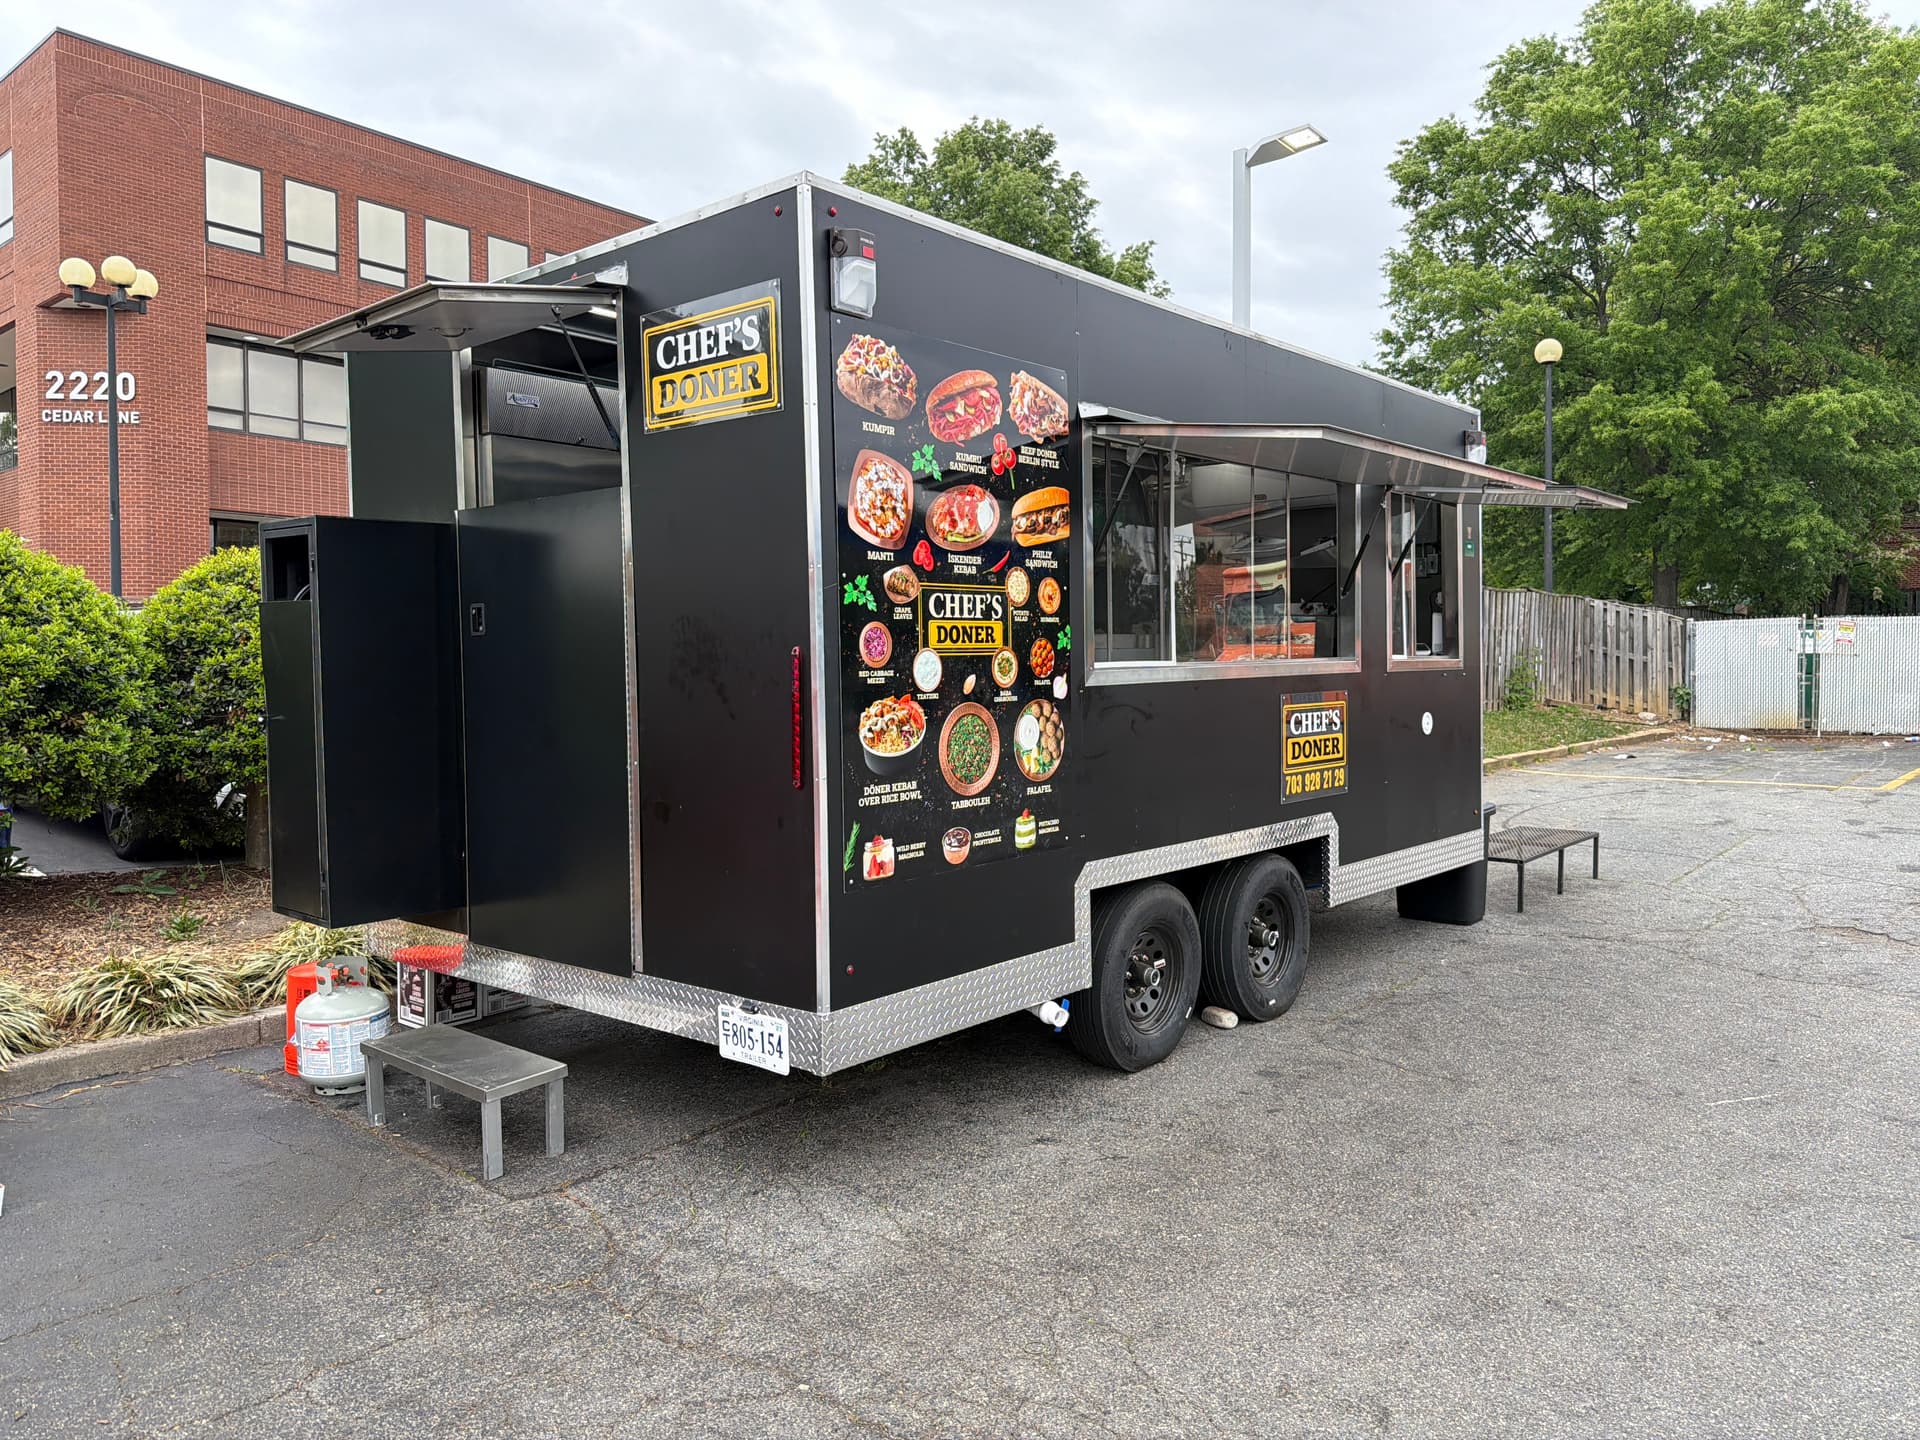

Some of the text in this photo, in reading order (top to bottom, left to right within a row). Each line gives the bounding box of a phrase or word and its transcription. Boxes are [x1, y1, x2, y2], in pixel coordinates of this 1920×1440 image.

[656, 315, 760, 369] CHEF'S
[45, 370, 135, 401] 2220
[659, 361, 761, 409] DONER
[42, 409, 140, 424] CEDAR LNE
[862, 421, 896, 436] KUMPIR
[955, 452, 983, 464] KUMRU
[1020, 446, 1036, 455] BEEF
[949, 462, 987, 475] SANDWICH
[1018, 455, 1060, 470] BERLIN STYLE
[867, 551, 895, 561] MANTI
[1032, 550, 1053, 559] PHILLY
[953, 565, 977, 574] KEBAB
[1025, 559, 1058, 569] SANDWICH
[928, 592, 1003, 619] CHEF'S
[936, 625, 996, 644] DONER
[1290, 709, 1341, 735] CHEF'S
[1291, 737, 1341, 760] DONER
[863, 781, 918, 796] DÖNER KEBAB
[1286, 767, 1345, 796] 703 928 21 29
[1026, 784, 1053, 796] FALAFEL
[858, 790, 922, 808] OVER RICE BOWL
[951, 796, 991, 810] TABBOULEH
